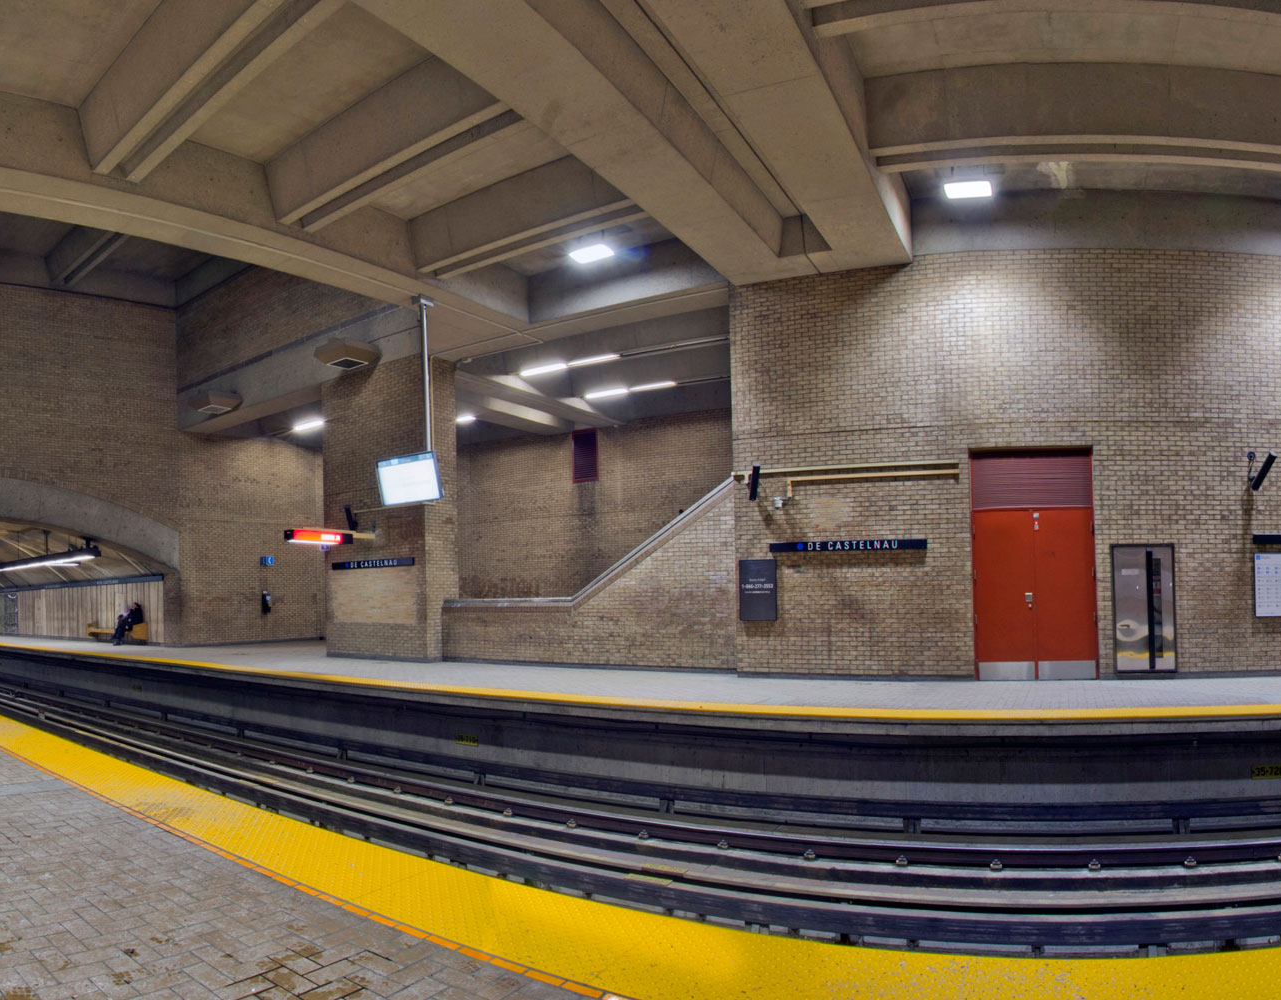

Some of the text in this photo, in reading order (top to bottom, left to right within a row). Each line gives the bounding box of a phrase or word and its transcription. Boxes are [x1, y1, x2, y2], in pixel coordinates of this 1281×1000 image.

[807, 539, 899, 551] DE CASTELNAU
[350, 559, 398, 569] DE CASTELNAU
